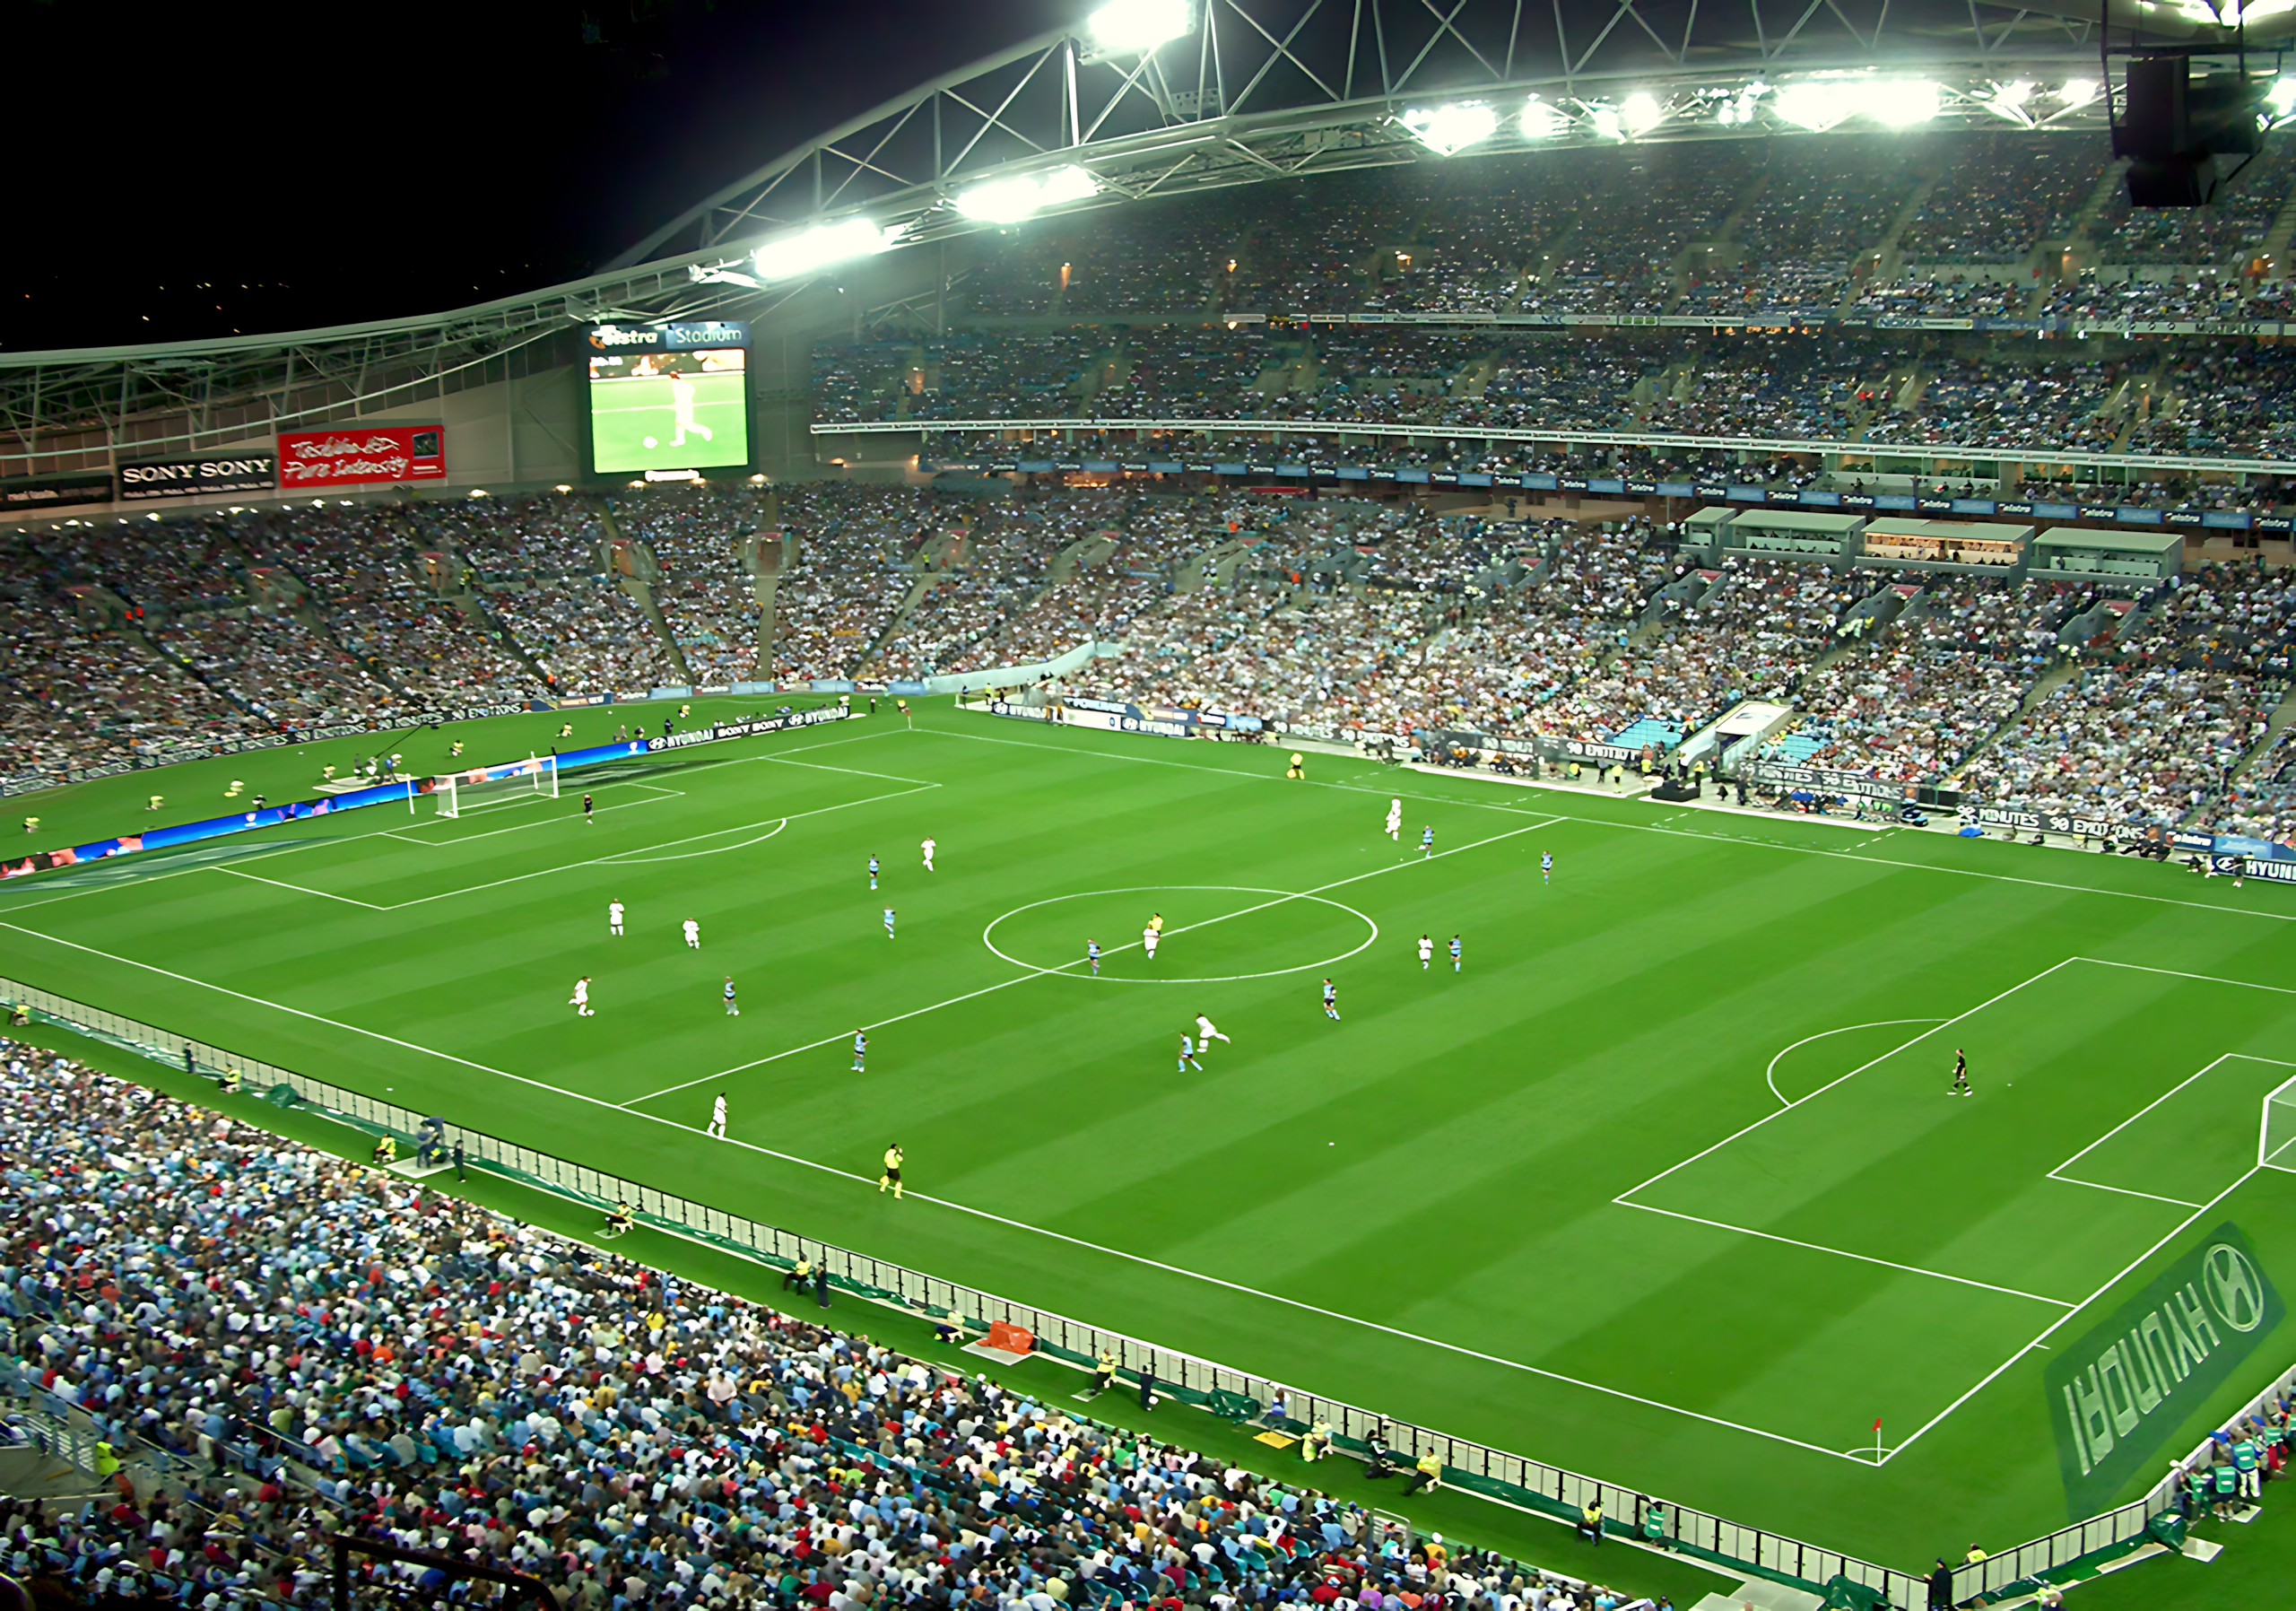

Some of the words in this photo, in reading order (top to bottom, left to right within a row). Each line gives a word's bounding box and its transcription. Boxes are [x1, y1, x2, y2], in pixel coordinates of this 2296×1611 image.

[675, 327, 743, 343] Stadium
[123, 464, 196, 483] SONY
[199, 458, 272, 477] SONY
[718, 725, 750, 737] SONY
[752, 718, 785, 732] SONY
[1979, 808, 2039, 827] MINUTES
[2049, 816, 2069, 831] 90
